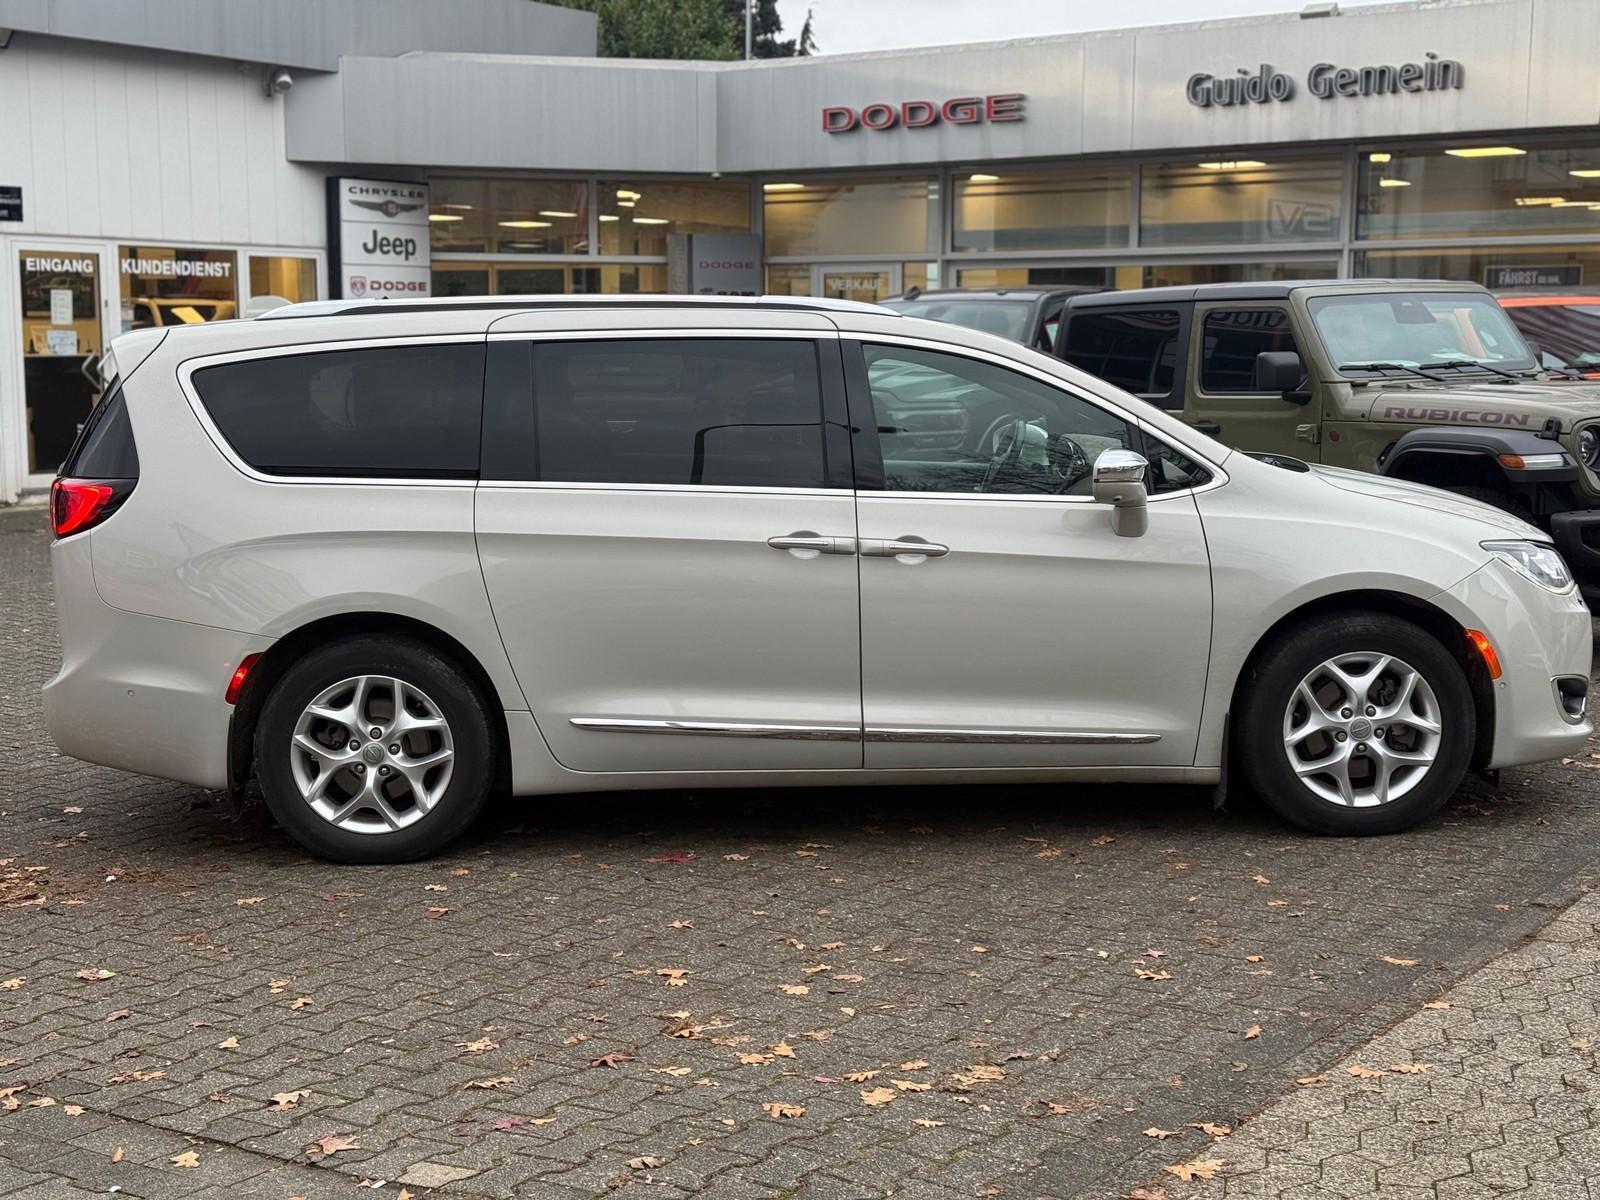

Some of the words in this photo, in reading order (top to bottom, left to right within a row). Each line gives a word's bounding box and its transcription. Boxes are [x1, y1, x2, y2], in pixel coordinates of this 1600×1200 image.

[1186, 63, 1296, 107] Guido
[1307, 52, 1465, 99] Gemein
[821, 92, 1027, 134] DODGE
[348, 185, 424, 199] CHRYSLER
[362, 229, 417, 261] Jeep
[26, 257, 94, 274] EINGANG
[121, 258, 232, 278] KUNDENDIENST
[699, 261, 753, 269] DODGE
[369, 280, 428, 292] DODGE
[831, 278, 883, 291] VERKAUF
[1383, 406, 1531, 427] RUBICON
